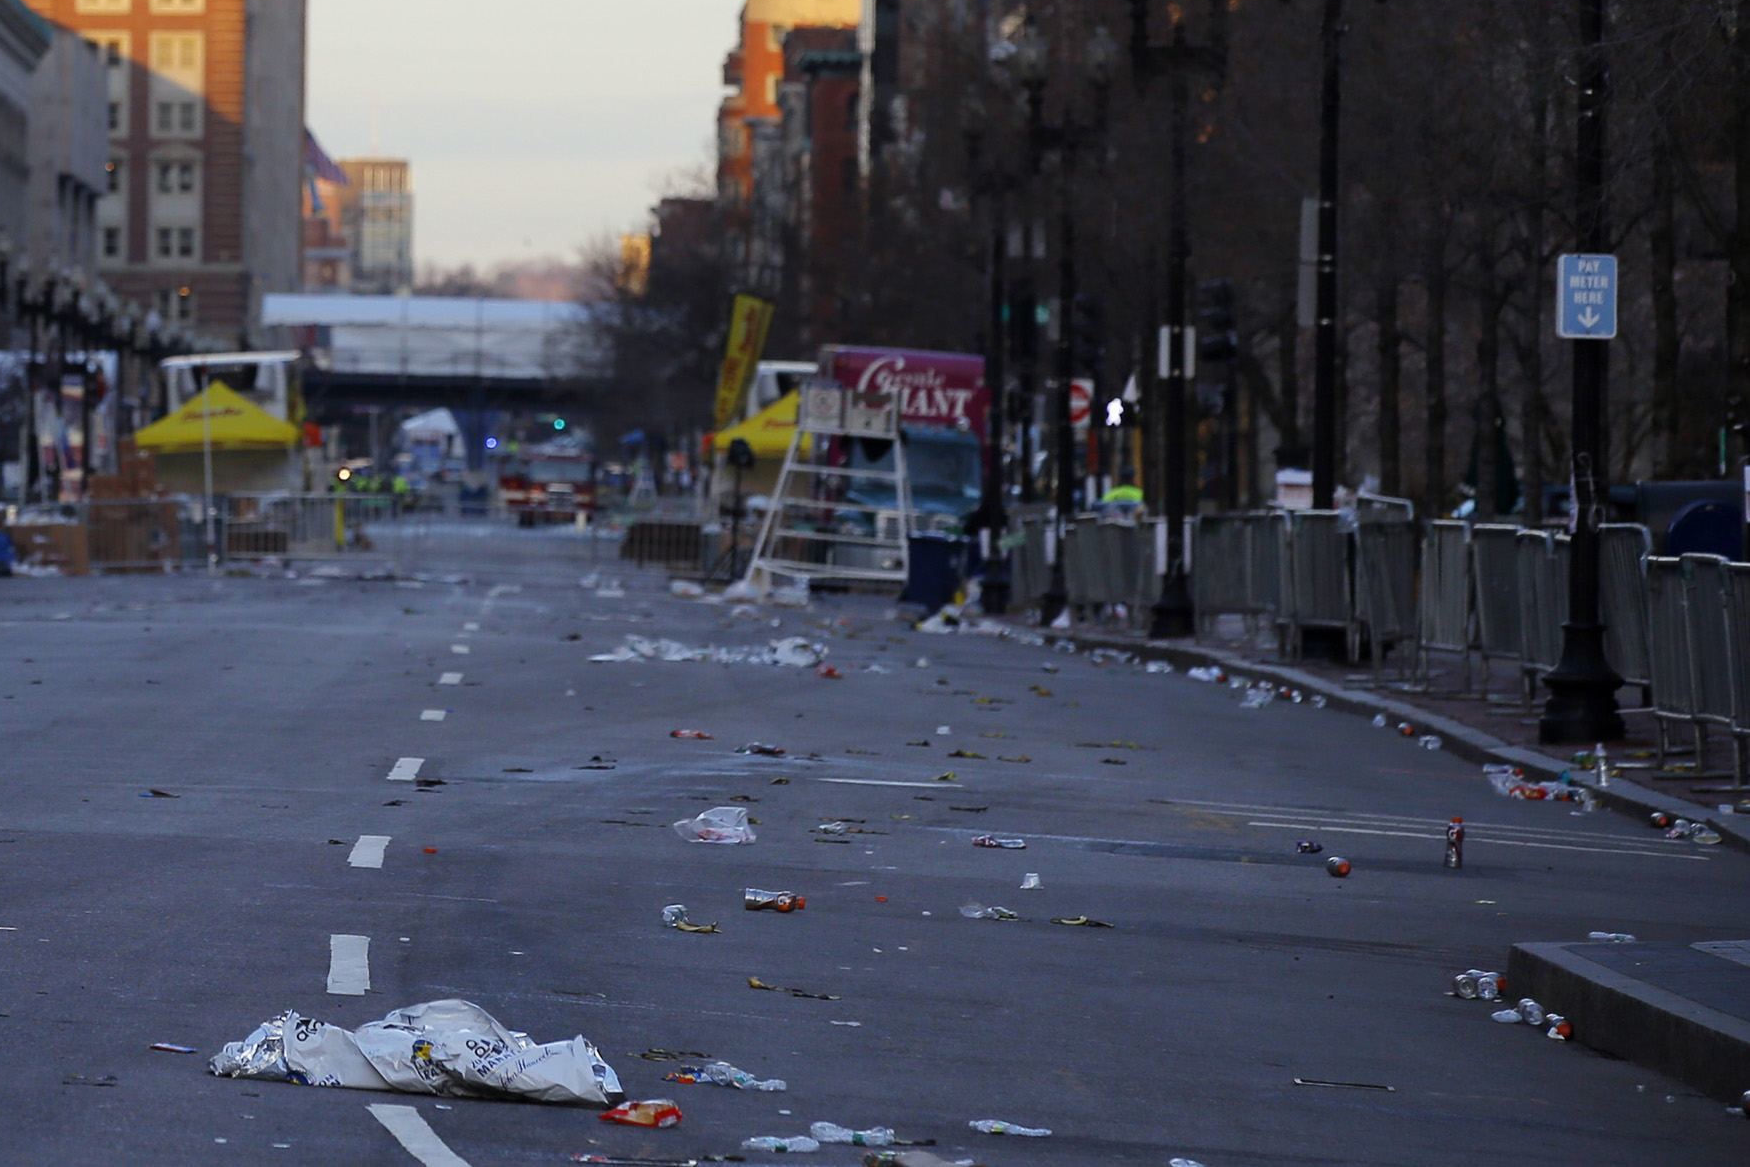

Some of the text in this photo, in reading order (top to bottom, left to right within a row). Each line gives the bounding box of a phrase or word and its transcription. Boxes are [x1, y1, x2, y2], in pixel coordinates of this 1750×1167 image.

[1578, 259, 1601, 273] PAY
[1570, 275, 1609, 289] METER
[1574, 291, 1604, 305] HERE
